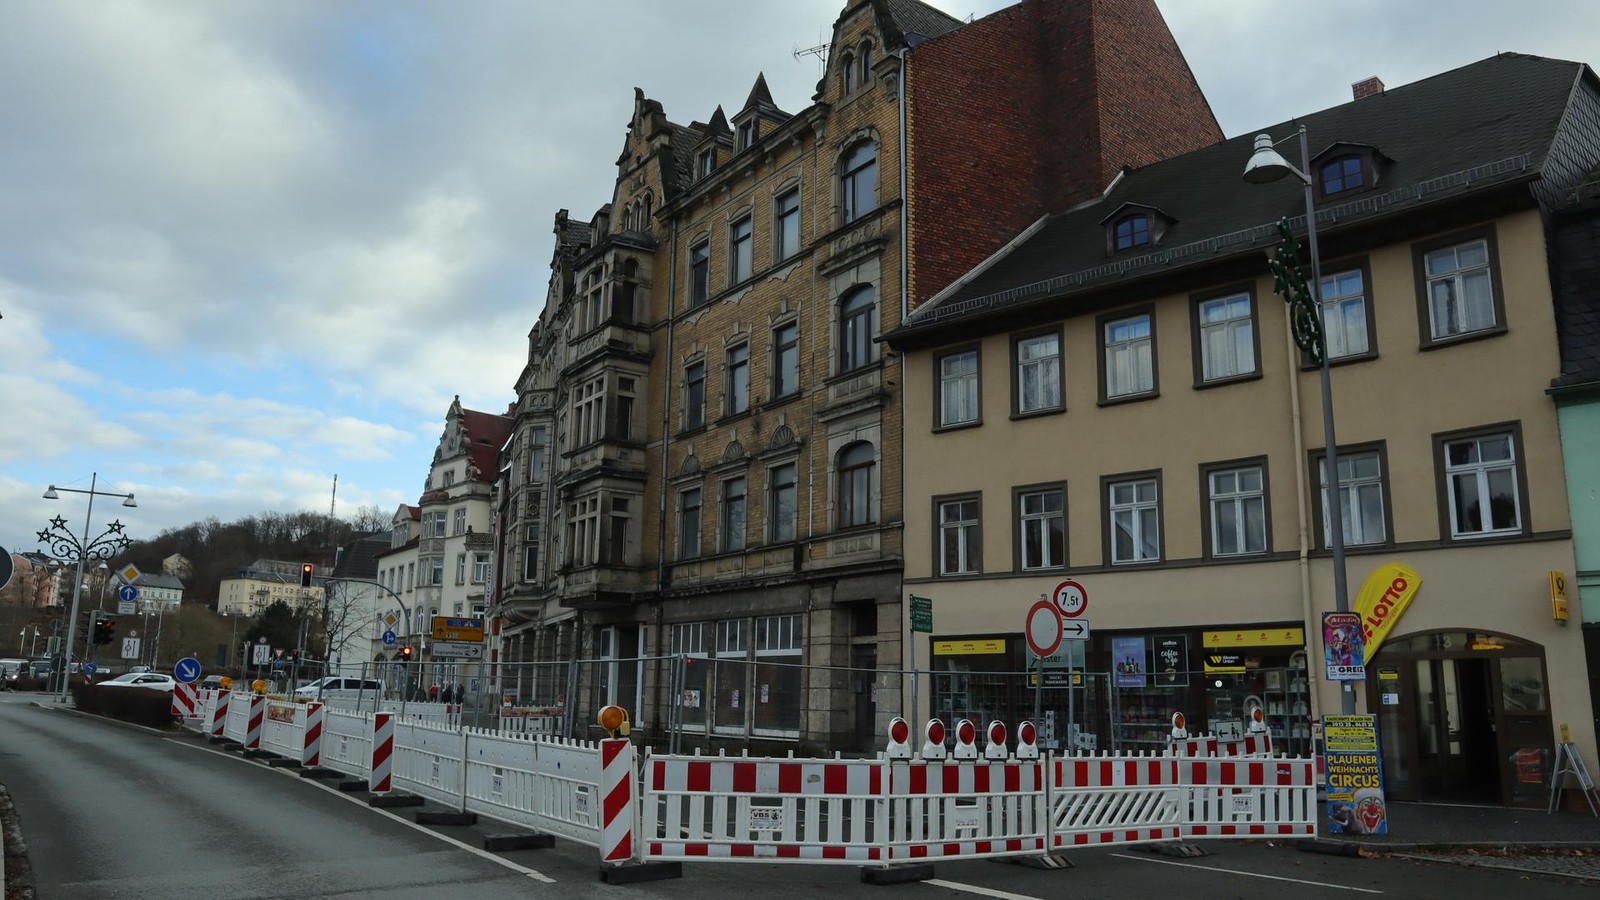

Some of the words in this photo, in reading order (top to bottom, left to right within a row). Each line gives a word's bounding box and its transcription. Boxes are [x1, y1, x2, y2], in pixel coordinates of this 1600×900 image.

[1366, 577, 1408, 628] LOTTO
[1327, 754, 1378, 765] PLAUENER
[1328, 766, 1379, 774] WEIHNACHTS
[1328, 774, 1380, 788] CIRCUS
